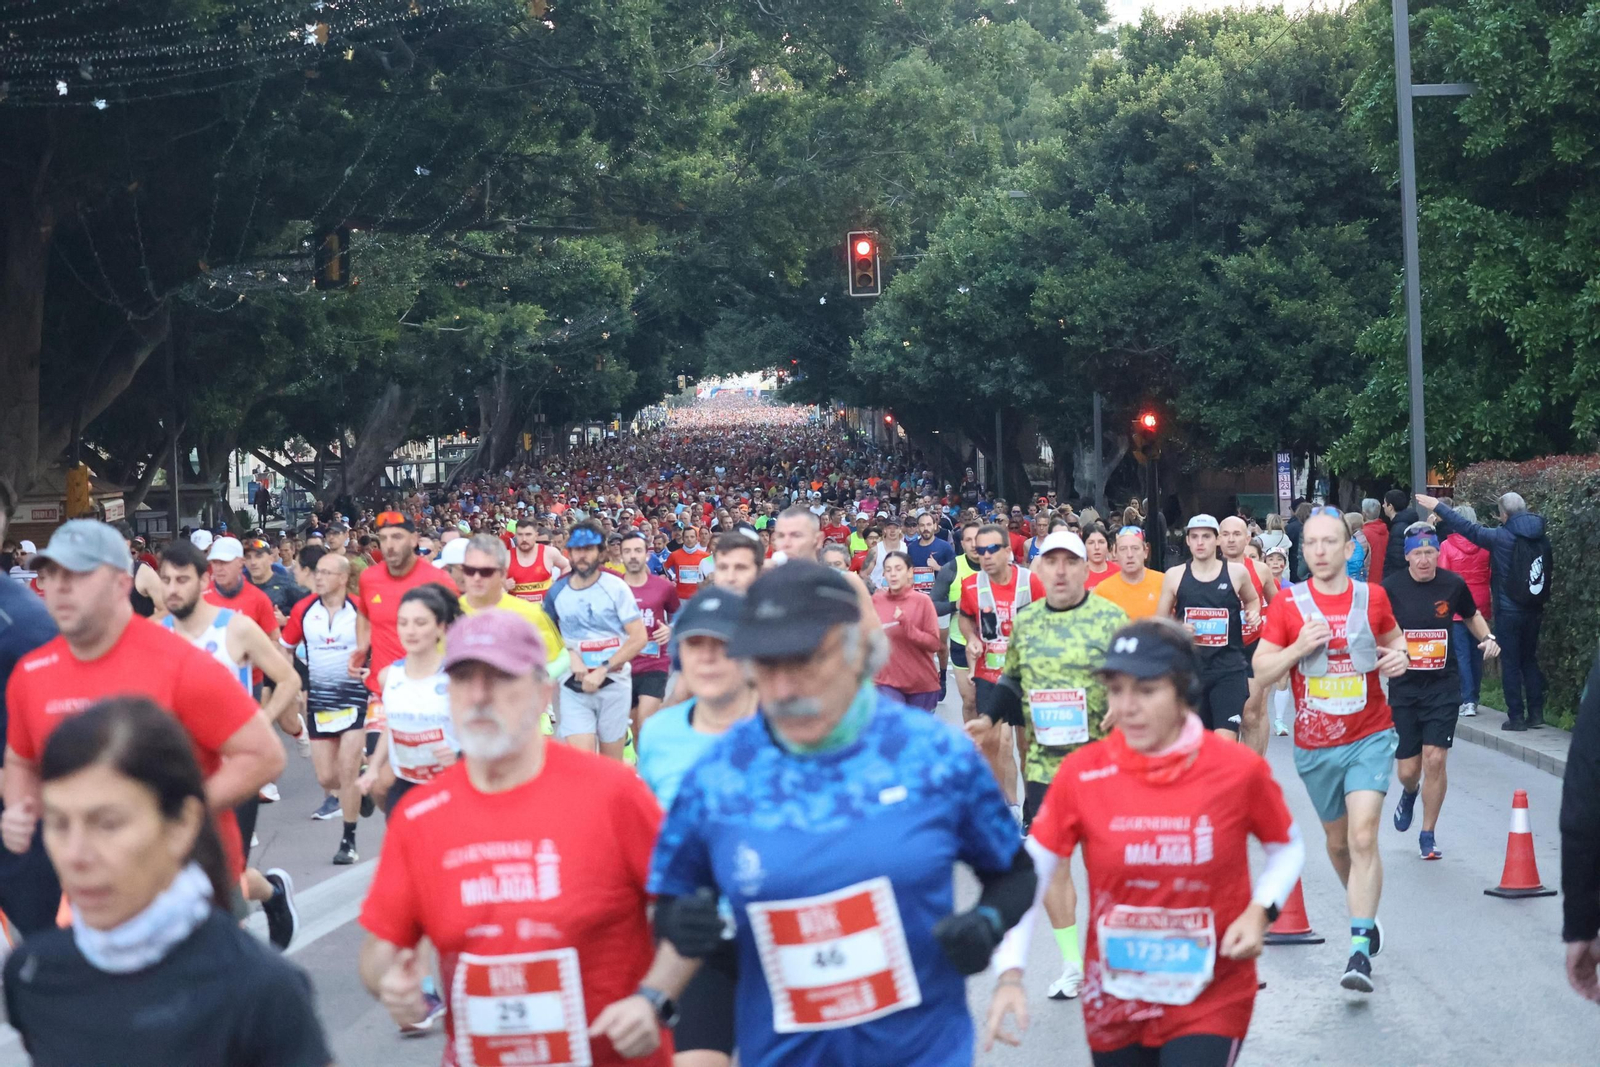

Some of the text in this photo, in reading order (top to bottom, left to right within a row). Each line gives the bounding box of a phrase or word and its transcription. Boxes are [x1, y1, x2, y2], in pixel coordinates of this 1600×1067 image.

[1277, 453, 1290, 463] BUS
[1280, 482, 1290, 490] 23
[1196, 621, 1218, 630] 6787
[1416, 631, 1445, 639] GENERALI
[1418, 643, 1435, 653] 246
[1319, 680, 1354, 691] 12117
[1039, 709, 1073, 721] 17786
[1124, 840, 1192, 866] MÁLAGA
